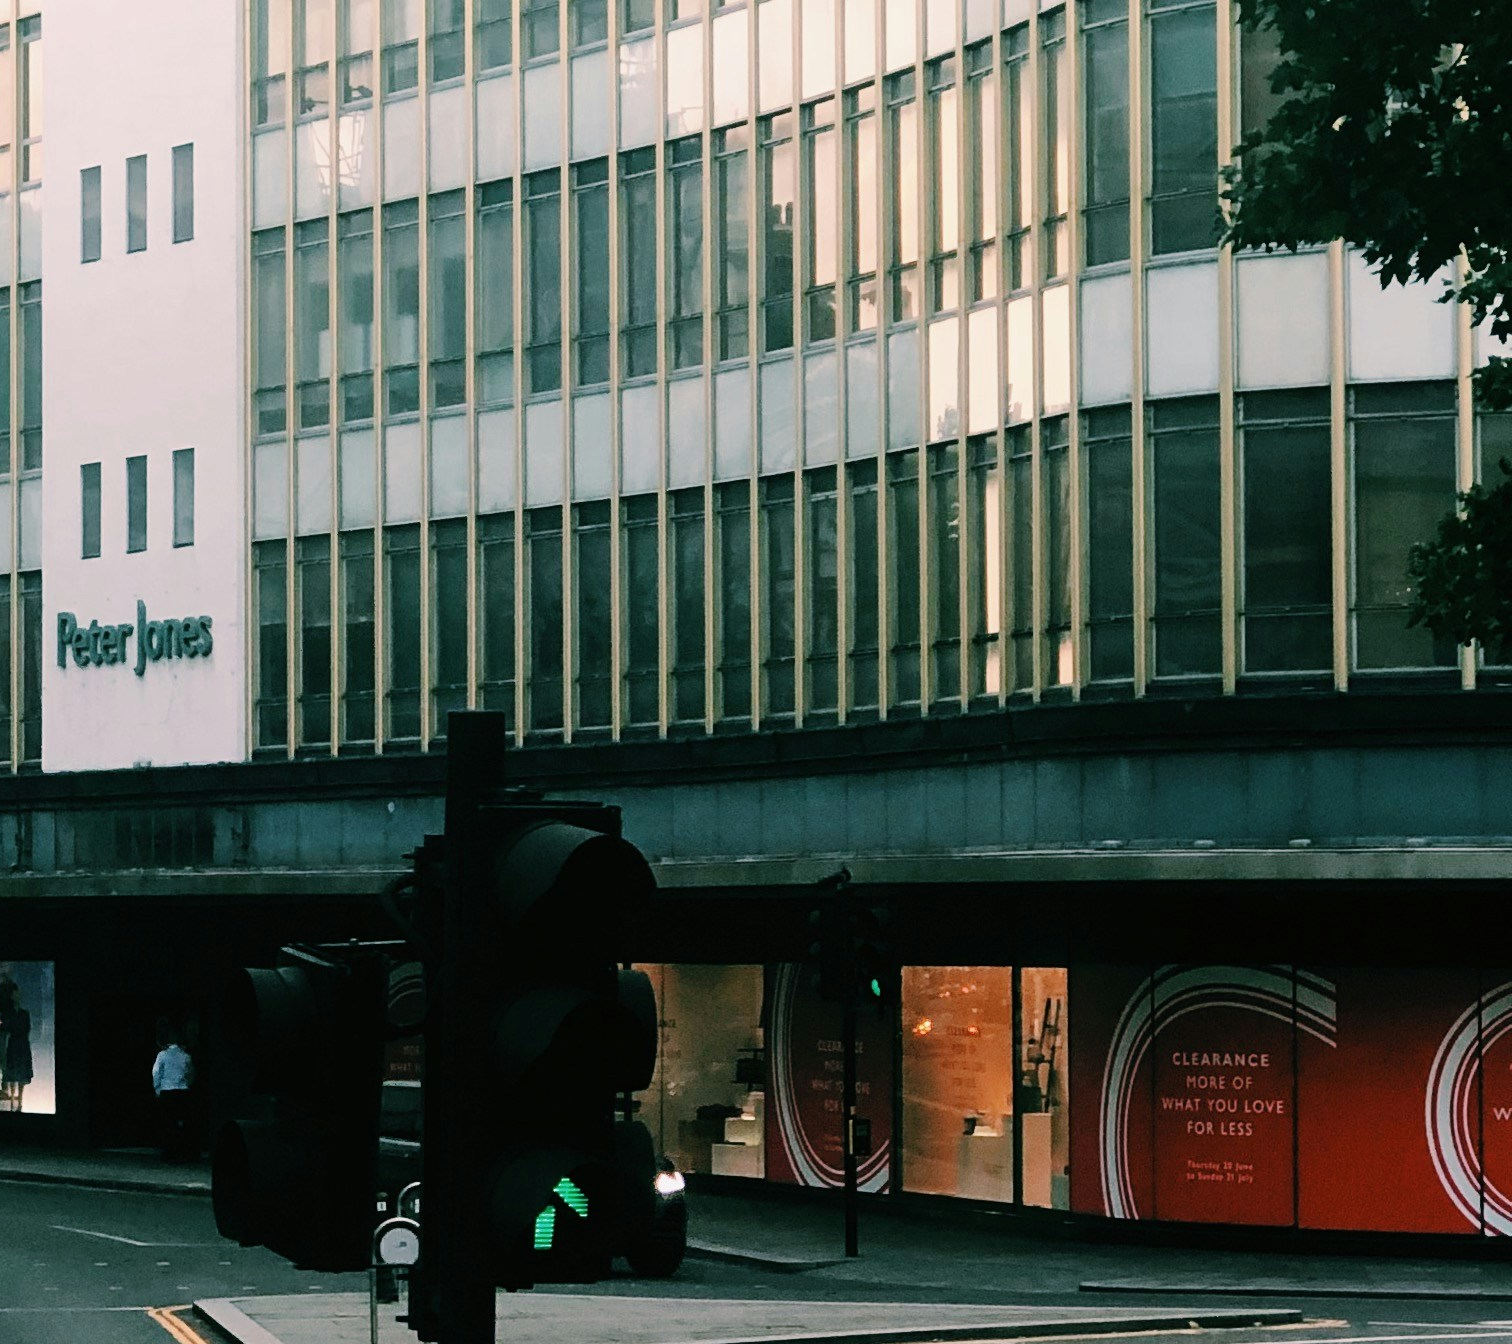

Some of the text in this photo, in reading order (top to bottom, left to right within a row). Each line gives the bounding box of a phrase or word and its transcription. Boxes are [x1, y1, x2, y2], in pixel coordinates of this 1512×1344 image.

[57, 599, 213, 677] Peter Jones
[1172, 1052, 1270, 1067] CLEARANCE
[1186, 1075, 1253, 1089] MORE OF
[1161, 1098, 1284, 1114] WHAT YOU LOVE
[1187, 1120, 1253, 1136] FOR LESS
